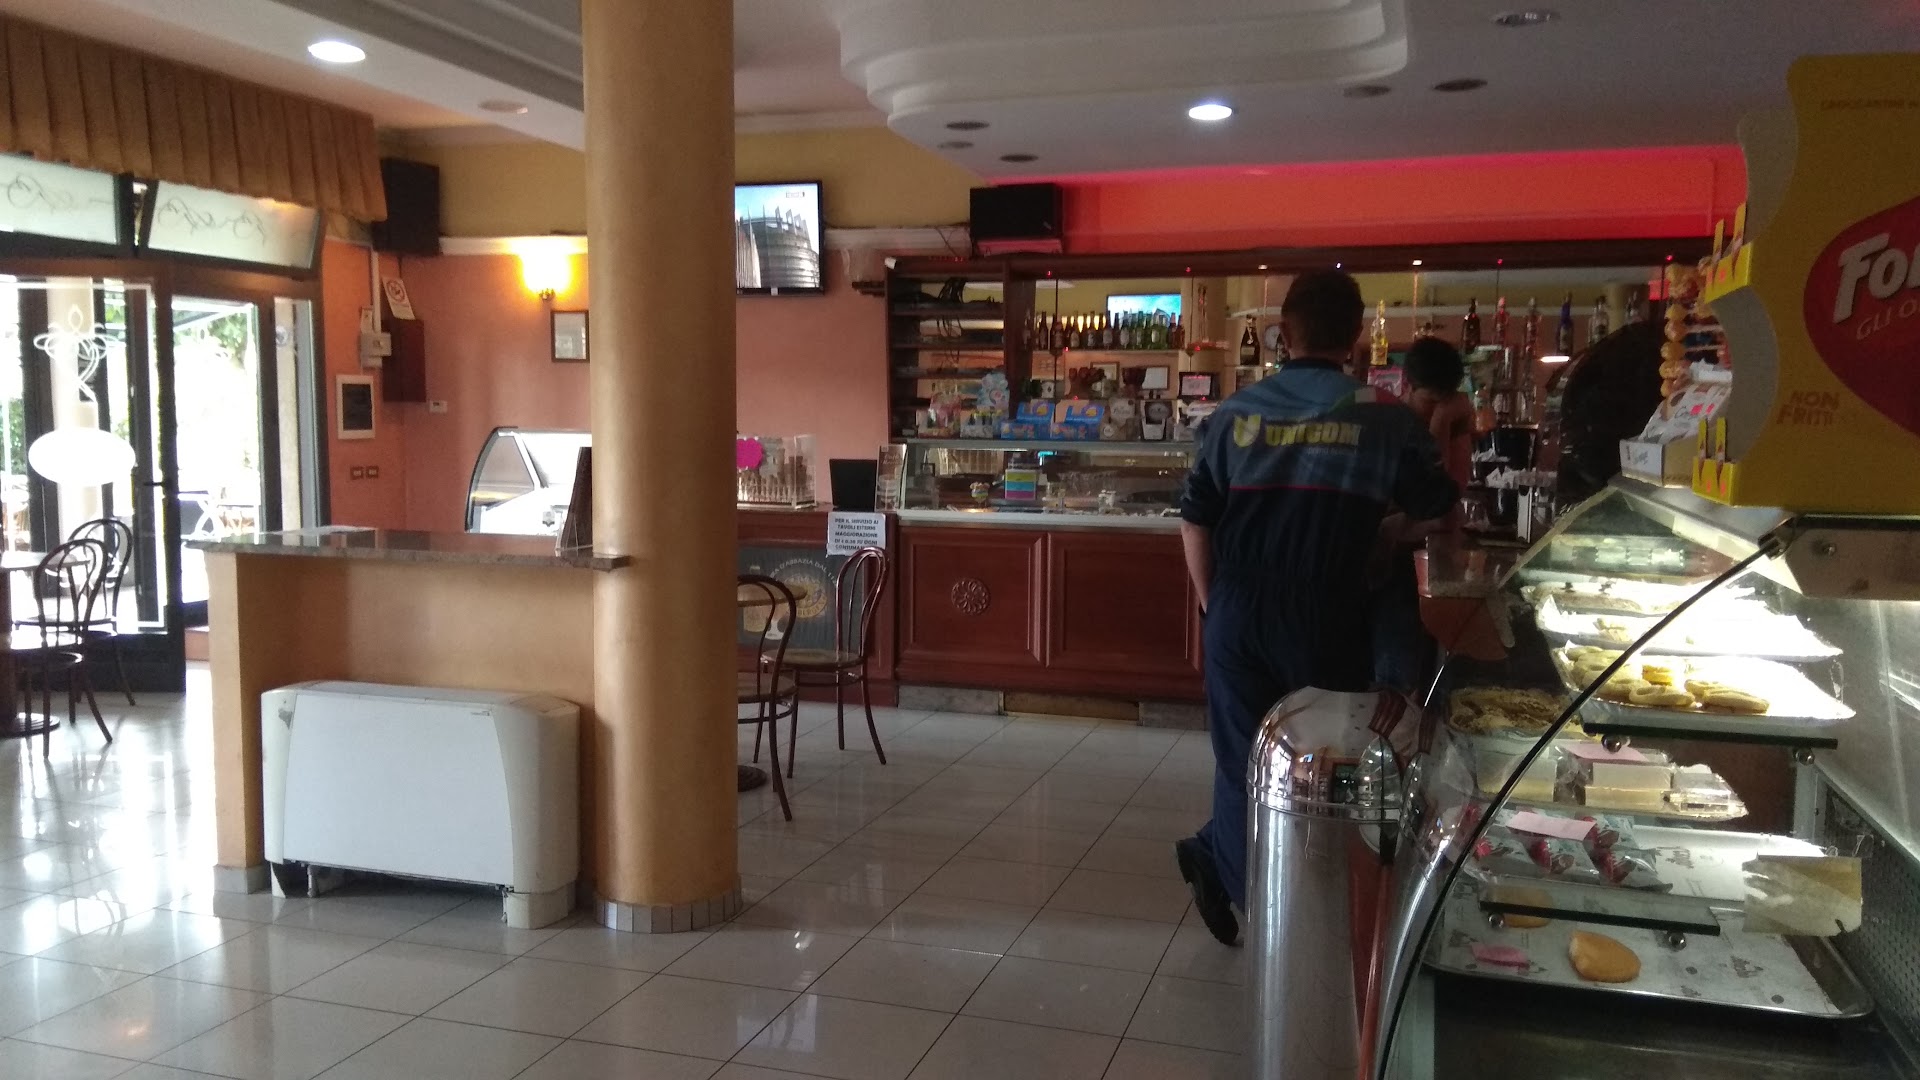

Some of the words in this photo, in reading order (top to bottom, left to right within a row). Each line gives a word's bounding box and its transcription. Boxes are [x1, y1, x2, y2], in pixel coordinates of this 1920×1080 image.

[1856, 306, 1892, 340] GLI
[1898, 298, 1920, 319] O
[1790, 391, 1840, 410] NON
[1776, 404, 1834, 426] FRITTI
